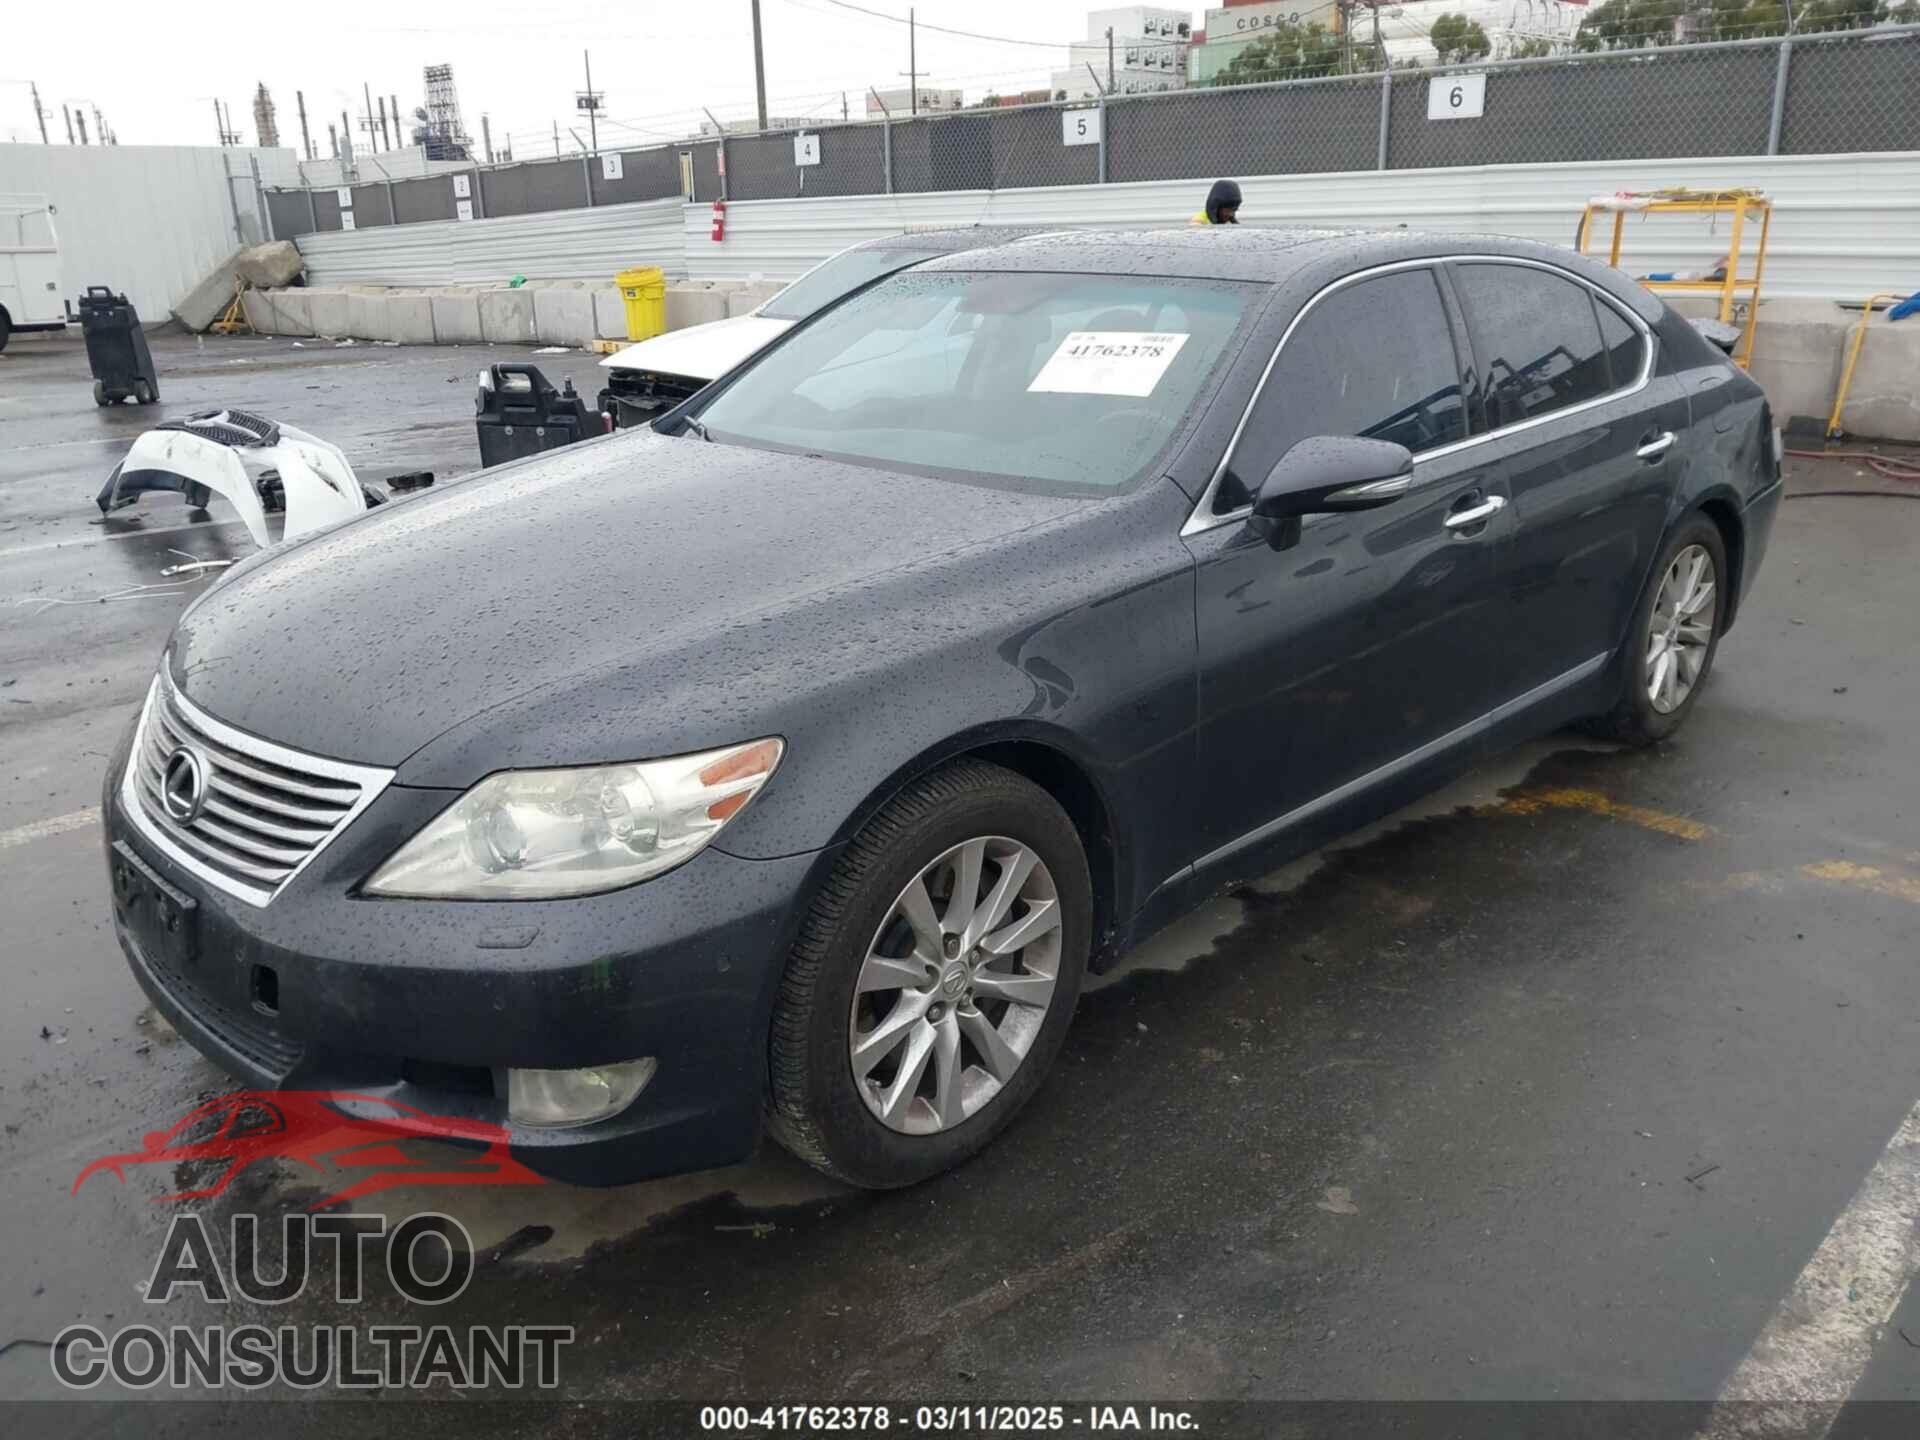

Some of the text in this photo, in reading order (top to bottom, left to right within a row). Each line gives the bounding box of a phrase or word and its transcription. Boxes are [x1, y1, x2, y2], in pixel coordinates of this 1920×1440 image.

[1236, 12, 1300, 30] COSCO
[1450, 86, 1463, 108] 6
[1077, 118, 1087, 136] 5
[804, 143, 812, 156] 4
[1069, 345, 1165, 357] 41762378
